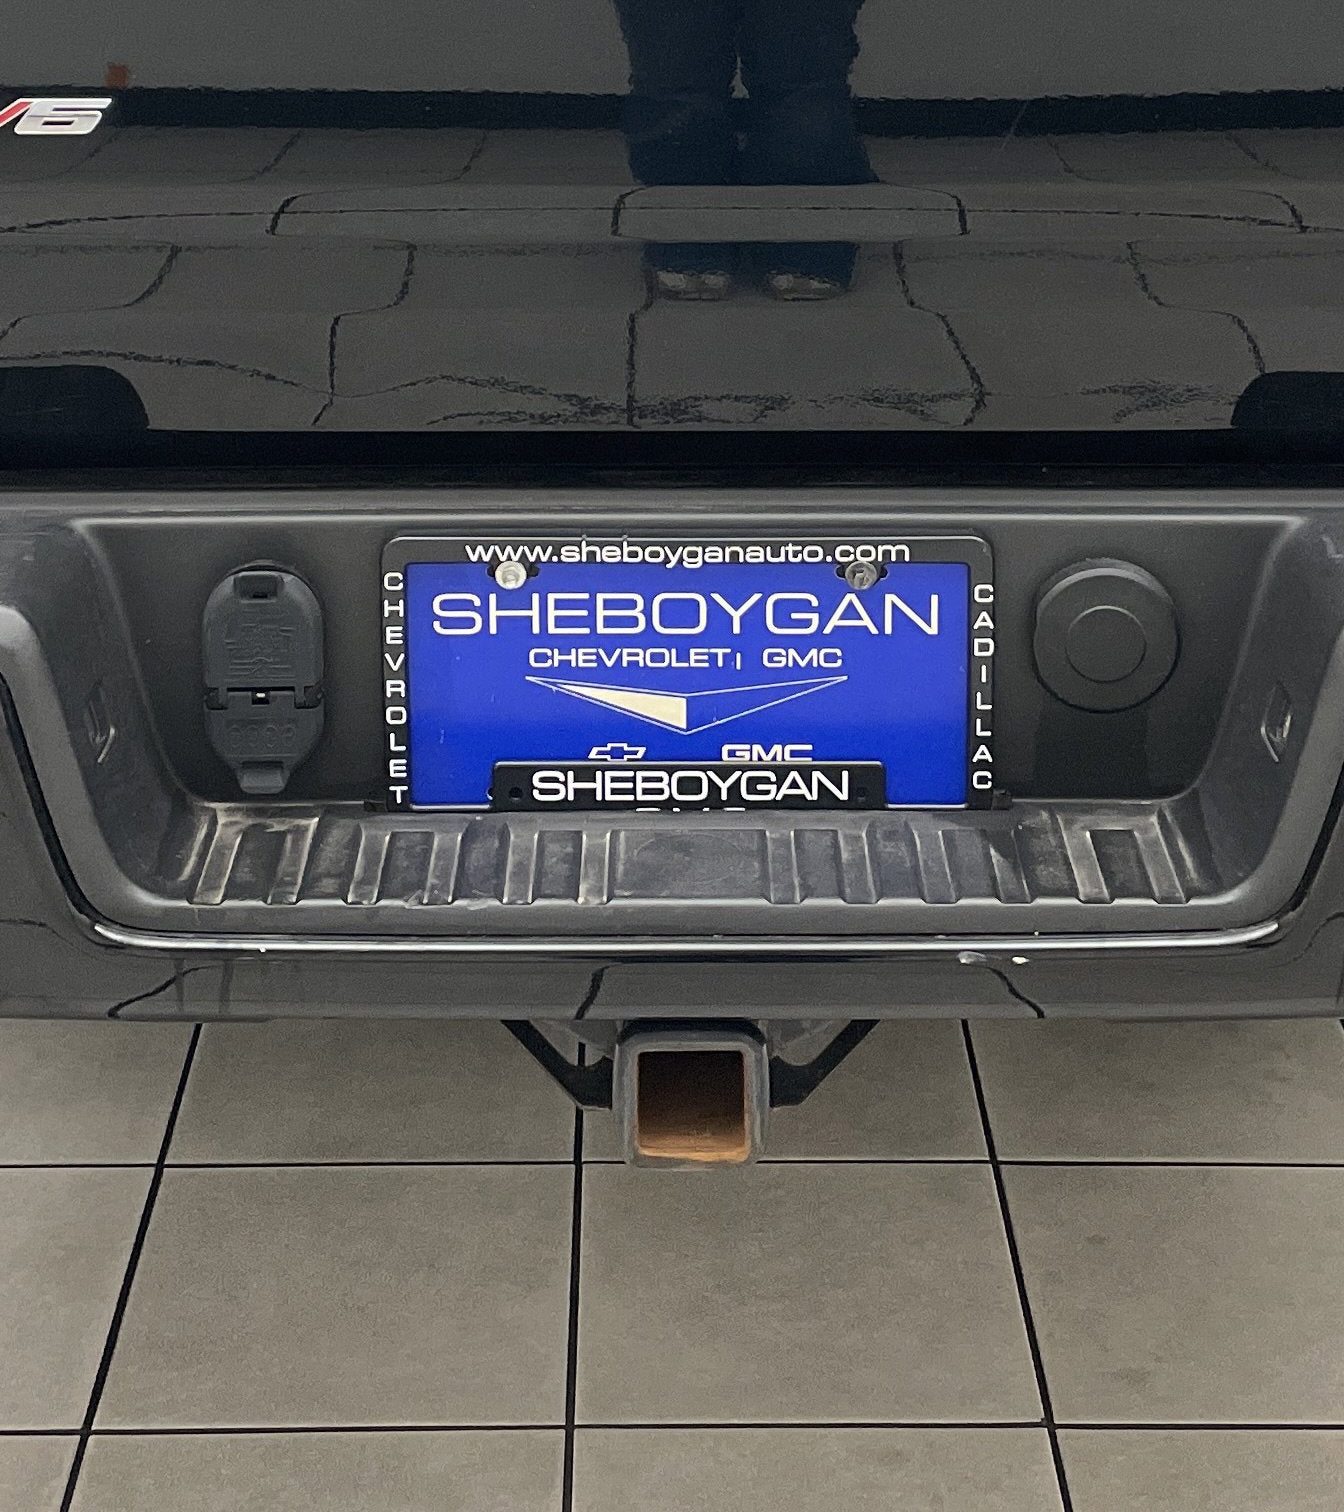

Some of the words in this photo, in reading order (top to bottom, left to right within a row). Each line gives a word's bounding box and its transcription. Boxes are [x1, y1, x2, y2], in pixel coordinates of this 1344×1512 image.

[465, 539, 911, 568] www.sheboyganauto.com
[432, 591, 939, 635] SHEBOYGAN
[528, 647, 732, 669] CHEVROLET
[762, 647, 844, 669] GMC
[382, 571, 409, 805] CHEVROLET
[972, 583, 995, 790] CADILLAC
[721, 744, 813, 762] GMC
[532, 770, 850, 803] SHEBOYGAN
